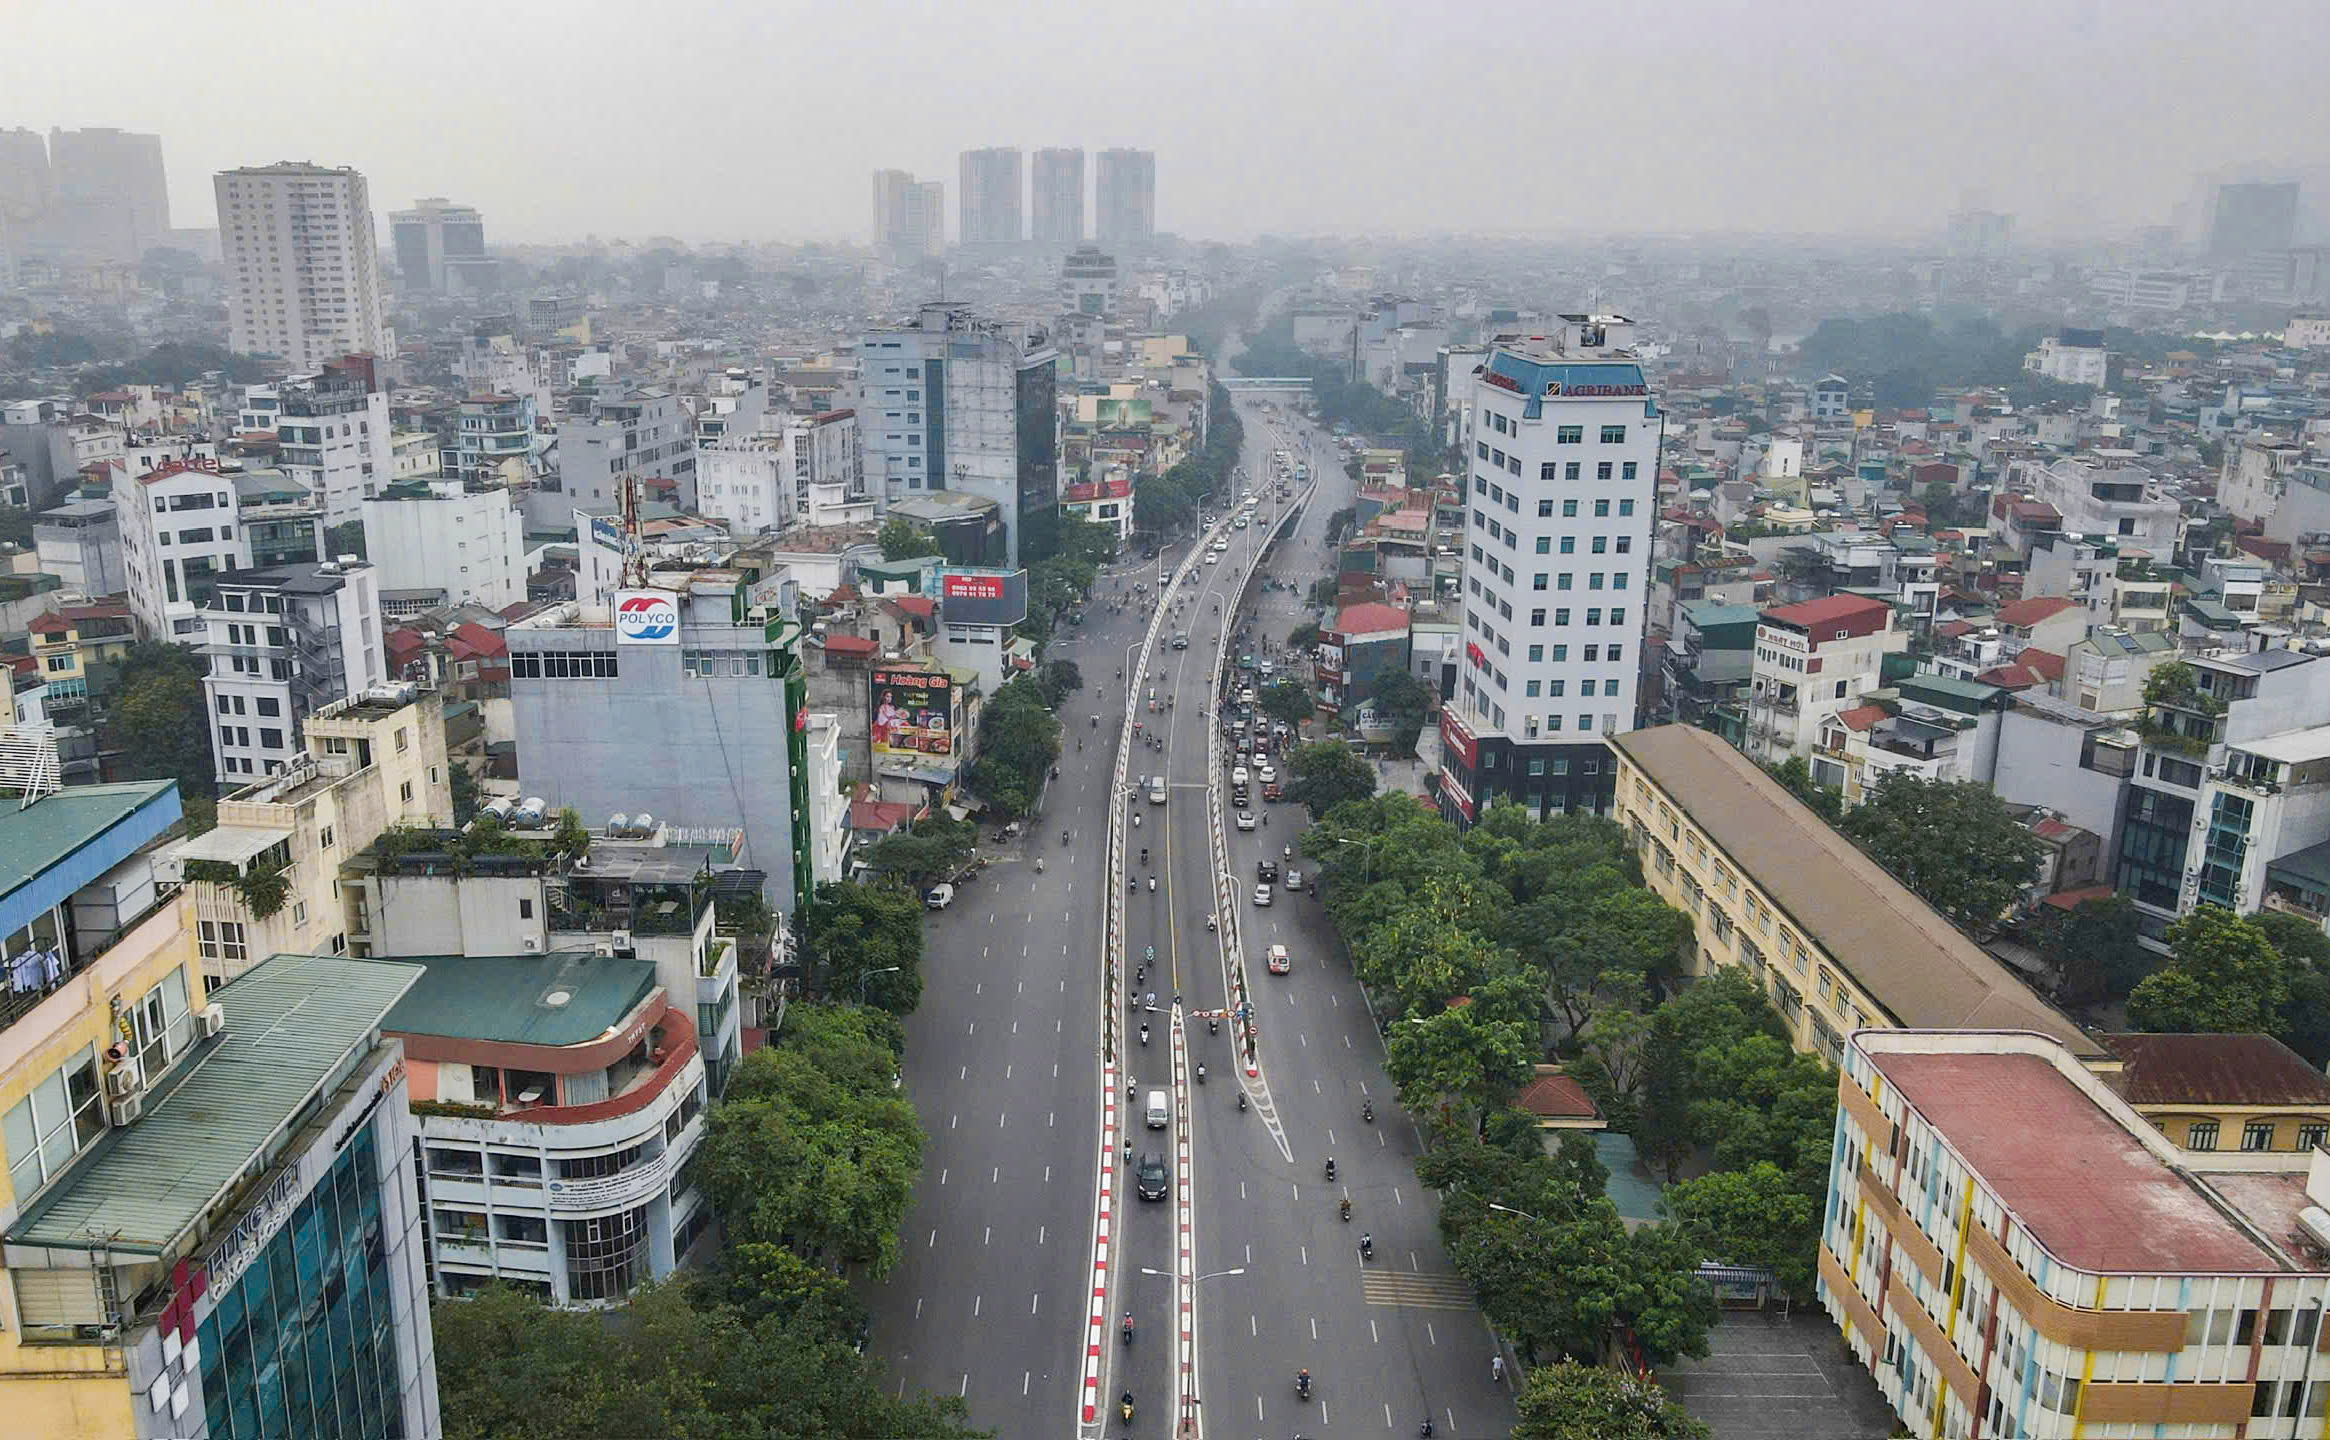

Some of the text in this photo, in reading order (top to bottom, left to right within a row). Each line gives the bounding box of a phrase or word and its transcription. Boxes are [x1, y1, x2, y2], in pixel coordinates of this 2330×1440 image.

[1563, 384, 1645, 397] AGRIBANK
[619, 613, 675, 624] POLYCO
[928, 676, 948, 688] Gia
[212, 1241, 257, 1300] CANCER
